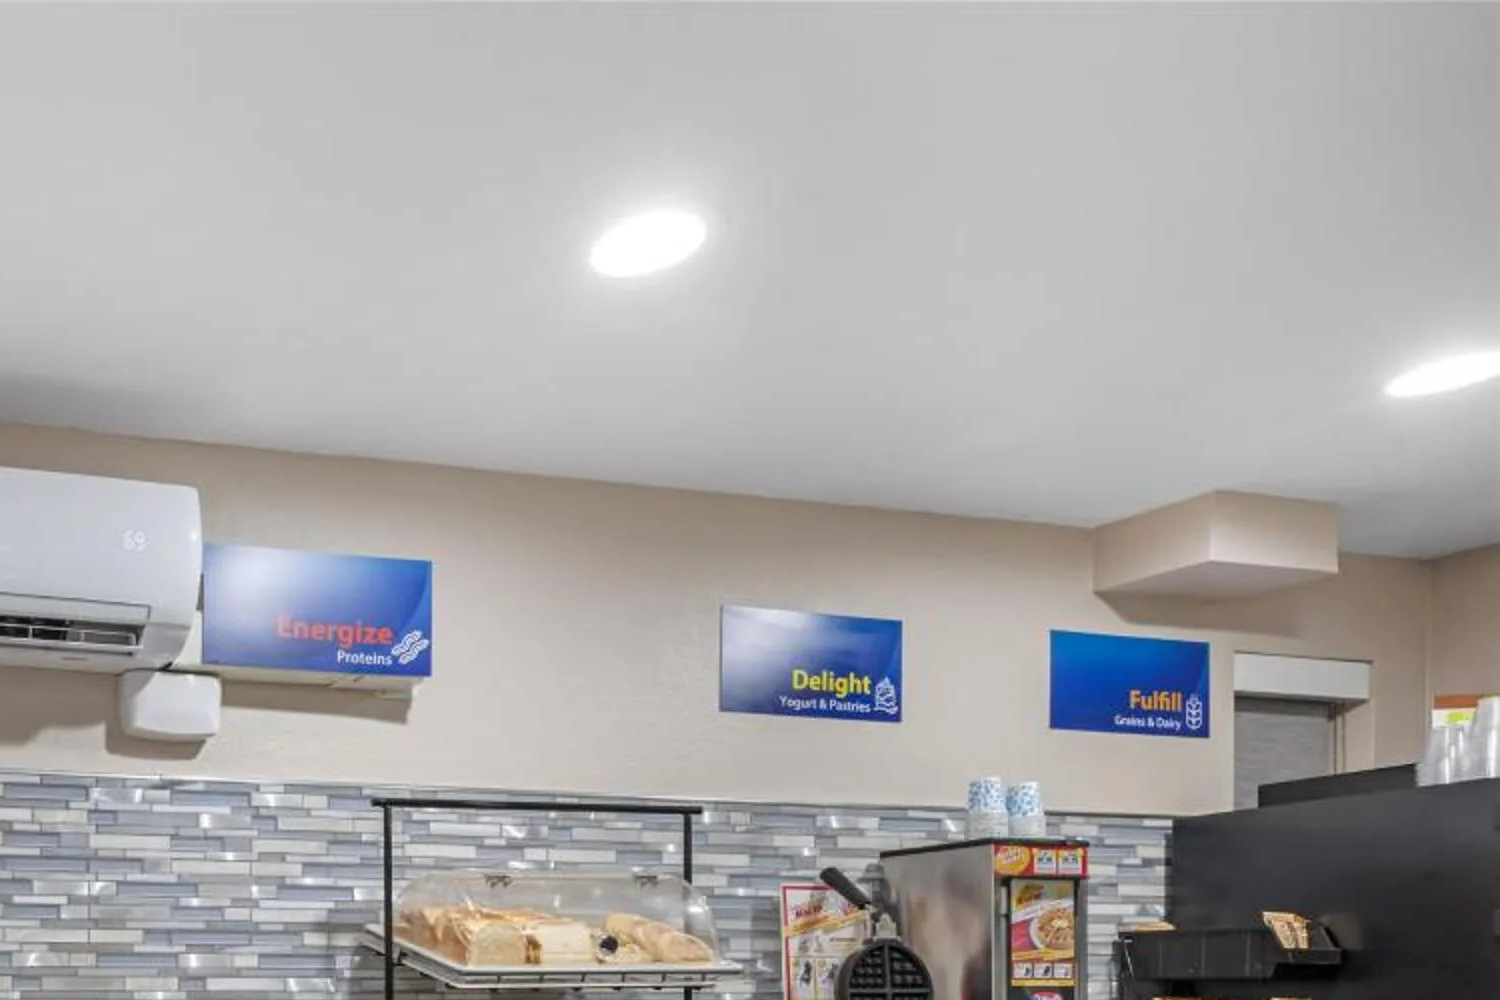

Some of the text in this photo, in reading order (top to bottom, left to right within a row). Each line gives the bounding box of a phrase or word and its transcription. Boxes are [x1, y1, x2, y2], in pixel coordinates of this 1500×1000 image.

[276, 611, 393, 648] Energize
[336, 650, 393, 666] Proteins
[792, 669, 871, 699] Delight
[779, 695, 871, 713] Yogurt & Pastries
[1129, 689, 1182, 713] Fulfill
[1114, 714, 1182, 732] Grains & Dairy
